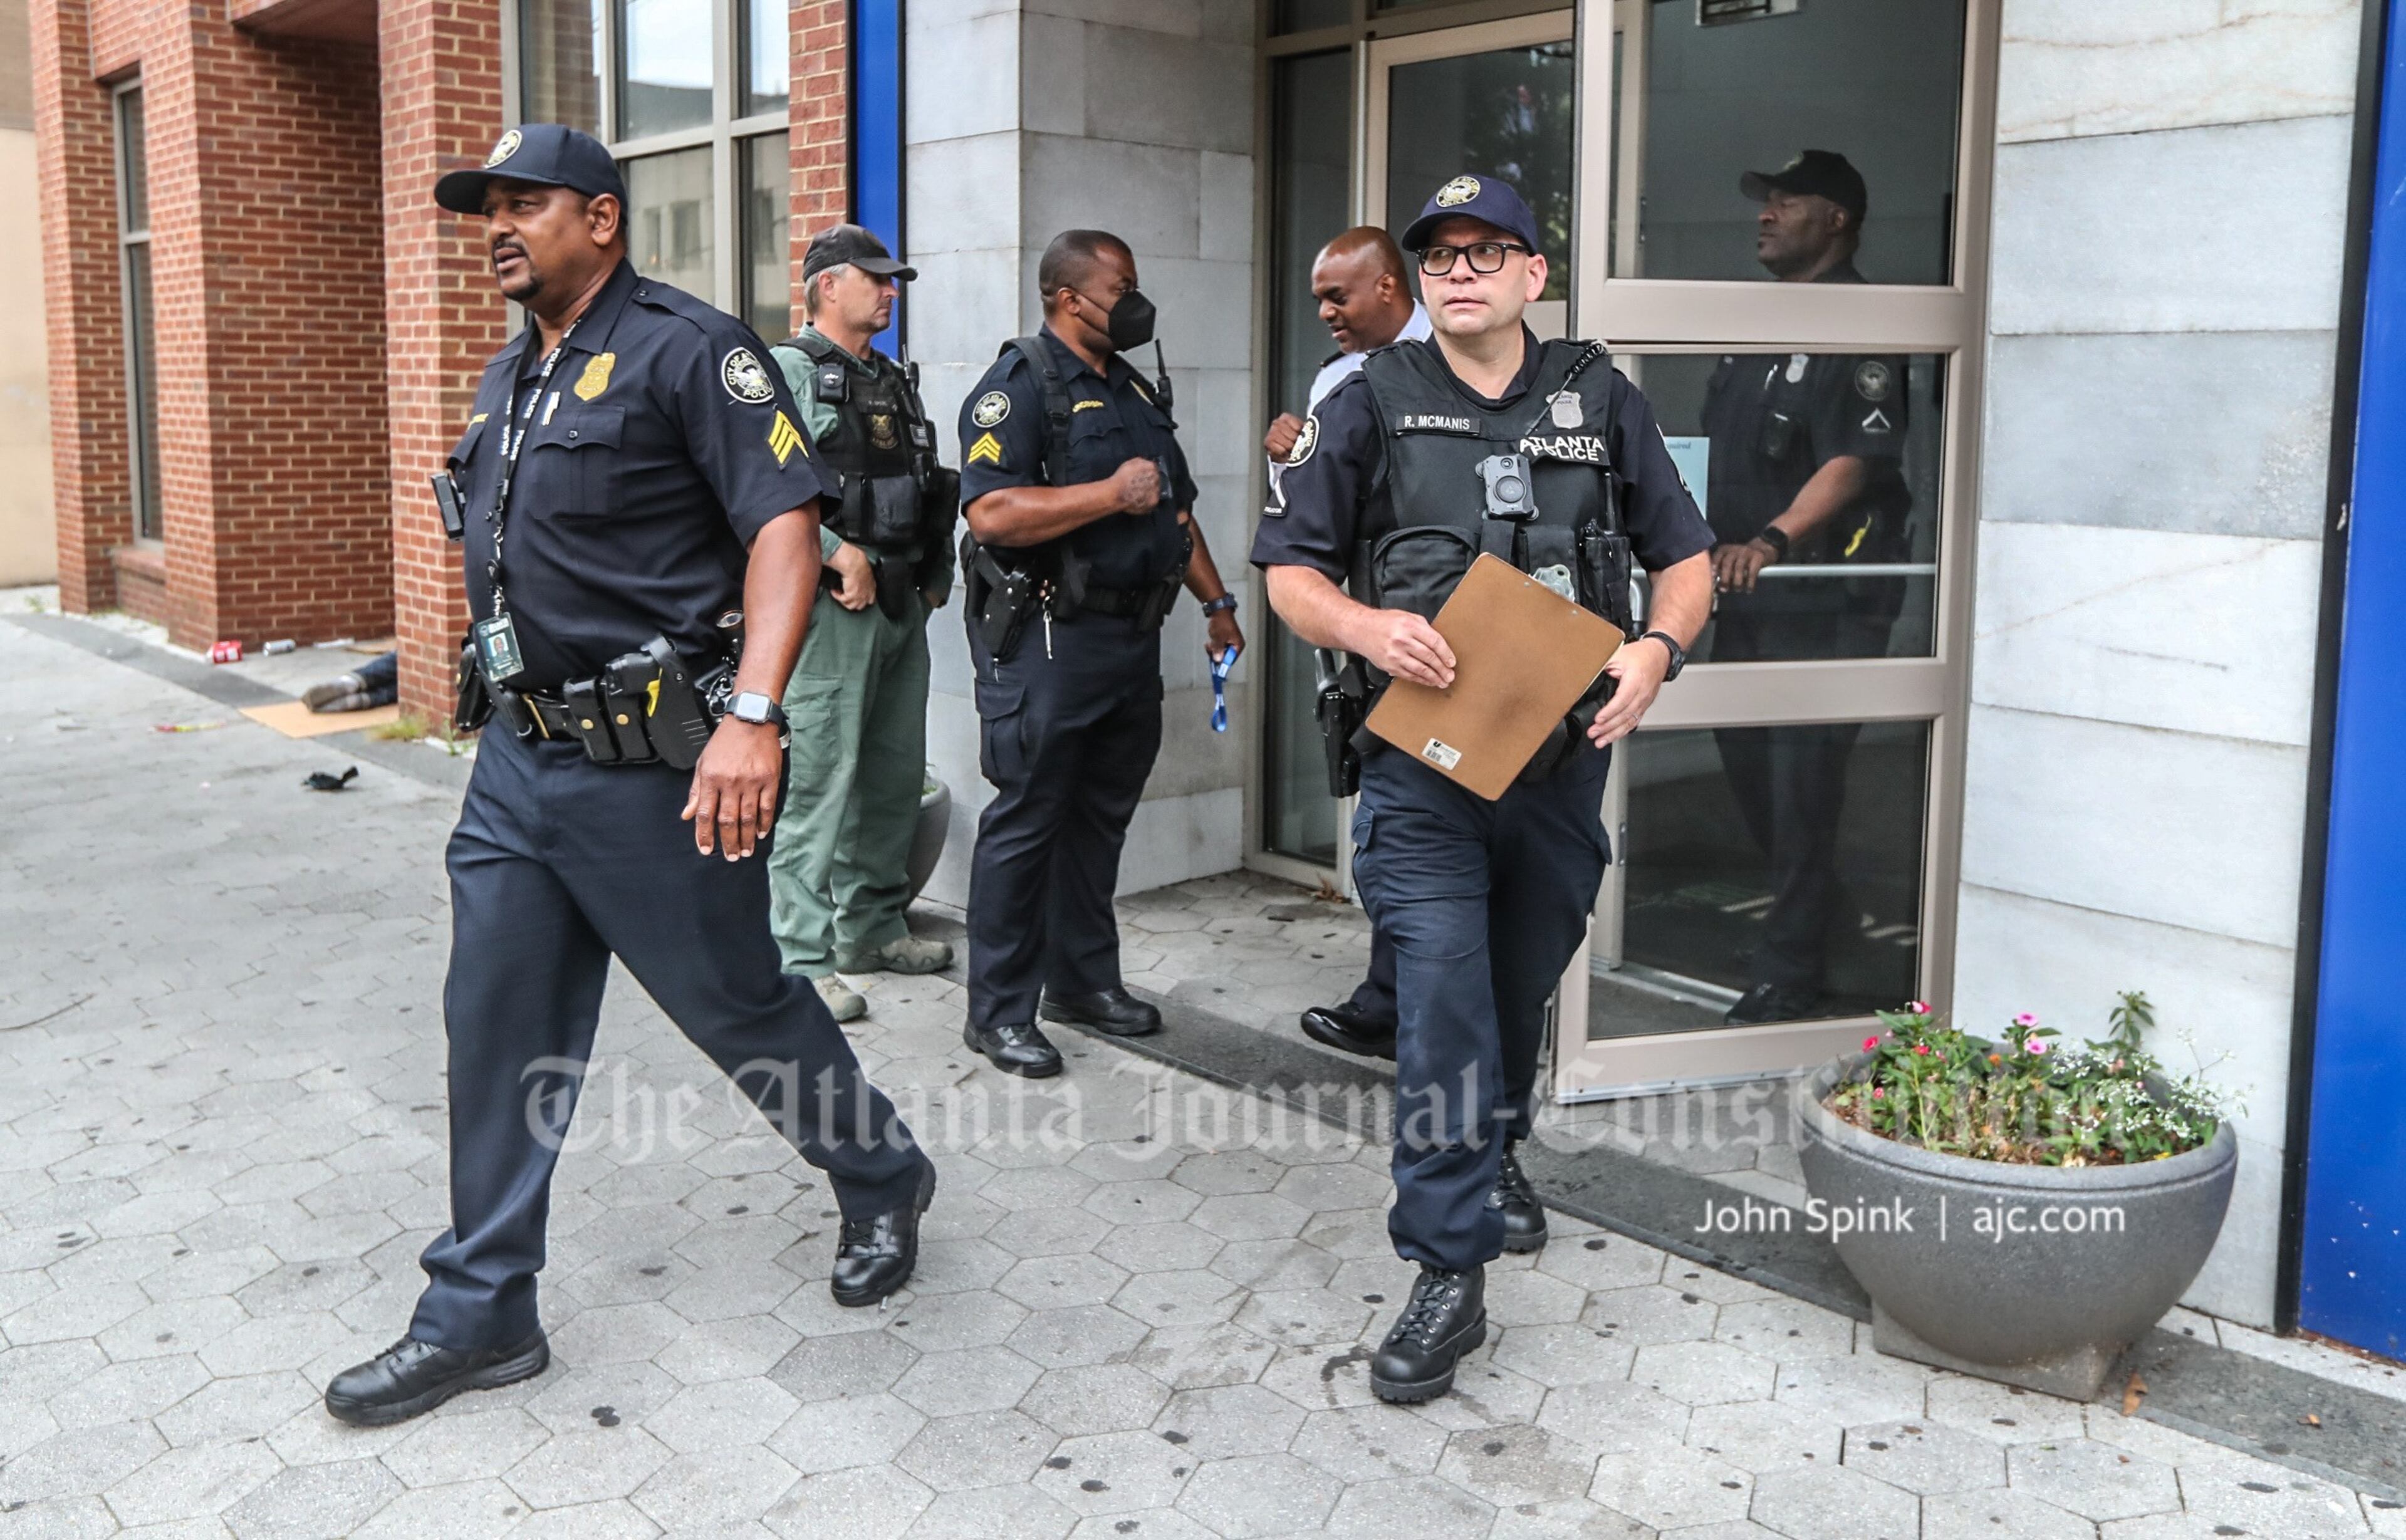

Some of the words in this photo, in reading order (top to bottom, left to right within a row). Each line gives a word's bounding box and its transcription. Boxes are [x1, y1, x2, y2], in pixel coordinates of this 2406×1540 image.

[541, 348, 561, 377] POLICE
[730, 355, 741, 367] OF
[727, 367, 737, 385] CITY
[743, 388, 773, 398] POLI
[523, 388, 543, 419] POLICE
[1404, 415, 1415, 428] R.
[1418, 415, 1471, 430] MCMANIS
[1519, 435, 1605, 453] ATLANTA
[1531, 445, 1600, 462] POLICE
